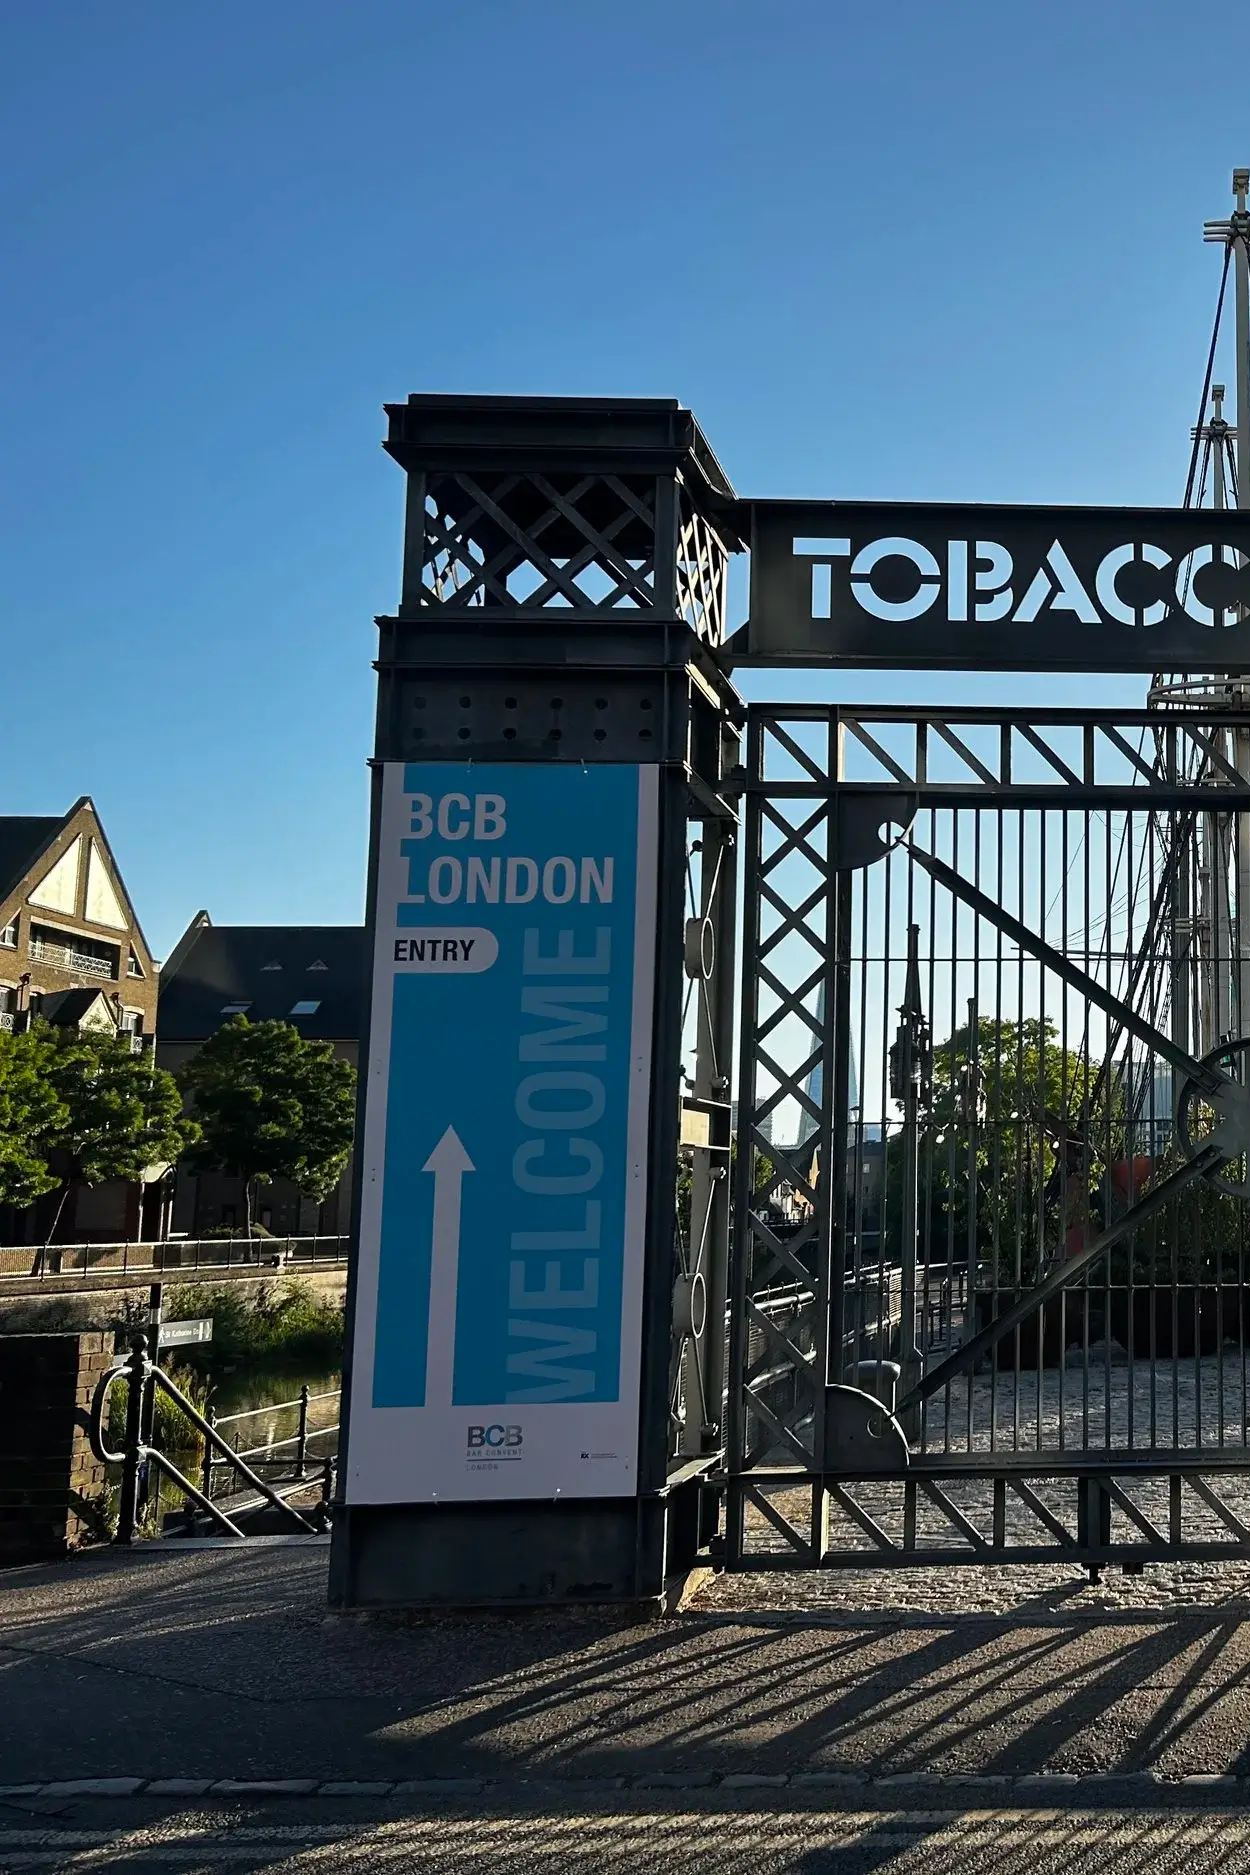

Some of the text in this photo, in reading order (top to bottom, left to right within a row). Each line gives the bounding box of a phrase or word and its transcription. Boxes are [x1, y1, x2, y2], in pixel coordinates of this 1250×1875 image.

[400, 792, 508, 841] BCB
[398, 855, 615, 905] LONDON
[393, 939, 476, 962] ENTRY
[505, 926, 612, 1405] WELCOME
[467, 1424, 524, 1448] BCB
[466, 1448, 523, 1457] BAR CONVENT
[466, 1463, 500, 1471] LONDON
